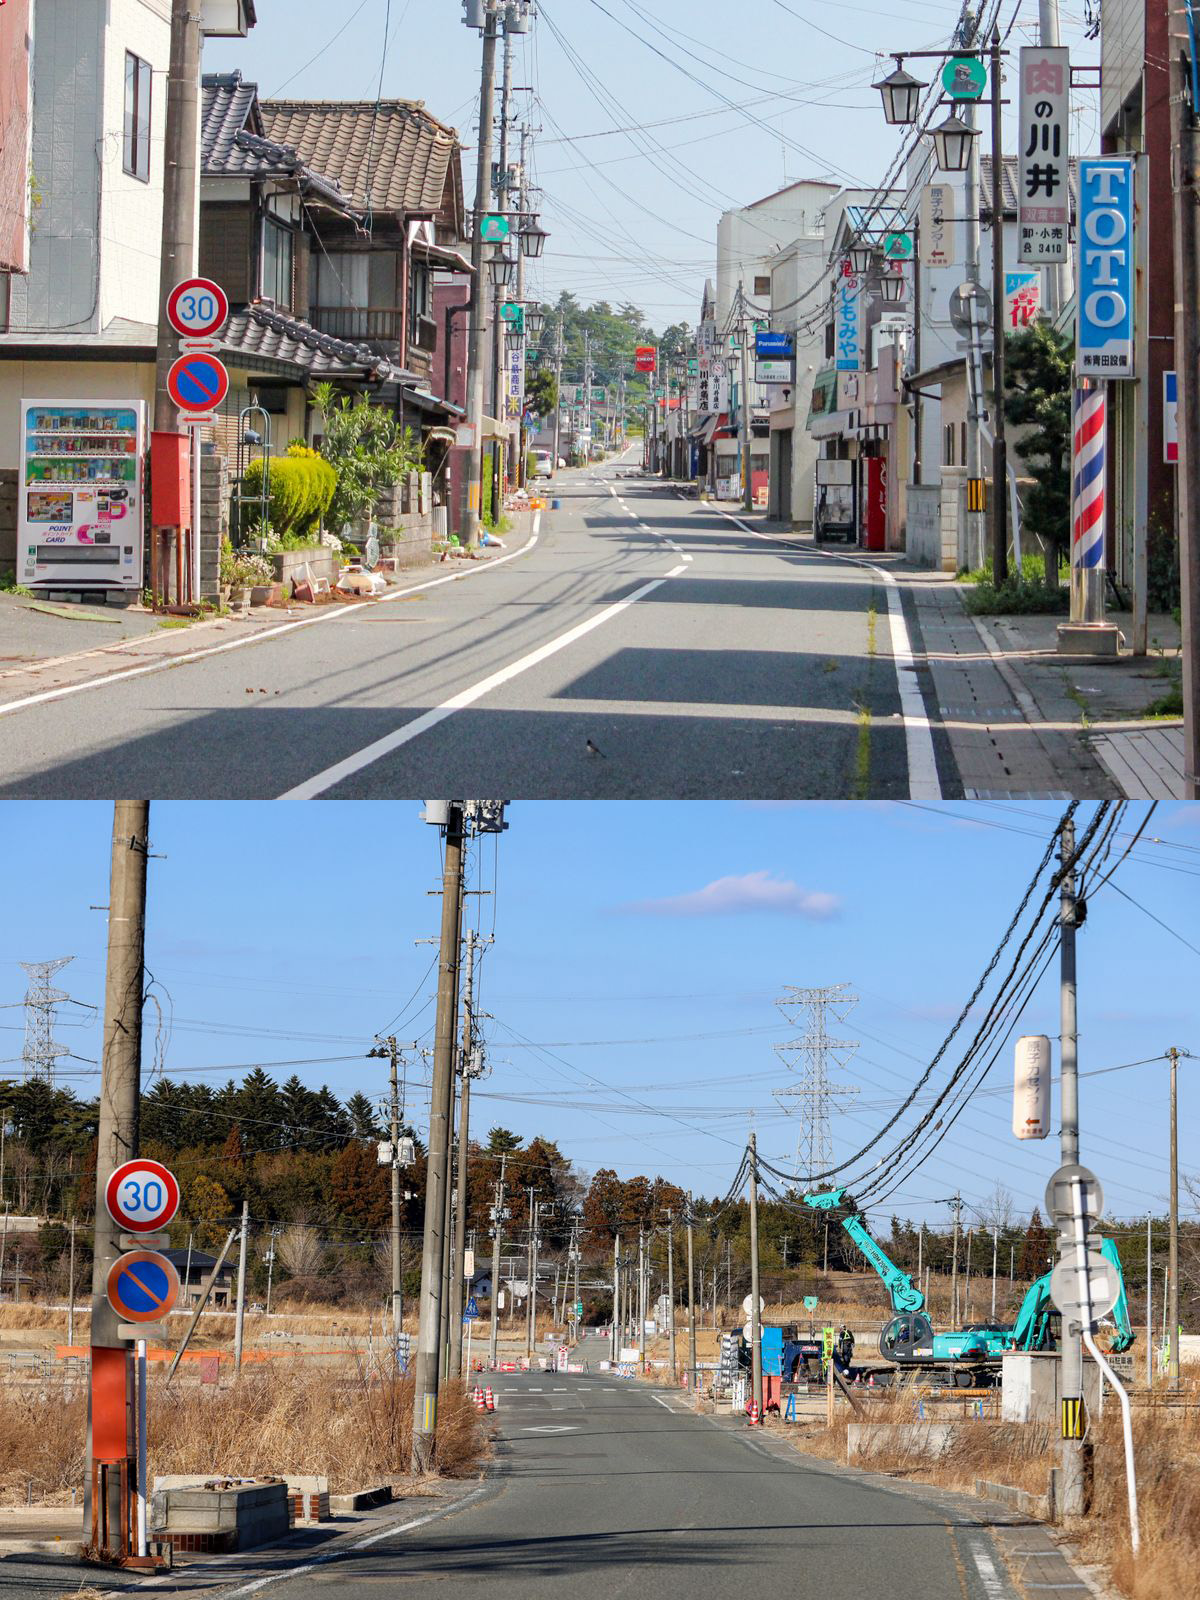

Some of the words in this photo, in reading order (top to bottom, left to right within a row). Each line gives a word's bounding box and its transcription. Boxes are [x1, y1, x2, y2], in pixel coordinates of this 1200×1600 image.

[1025, 58, 1063, 198] 肉の川井
[1039, 244, 1061, 253] 3410
[1085, 168, 1126, 327] TOTO
[181, 296, 213, 320] 30
[123, 1181, 162, 1212] 30
